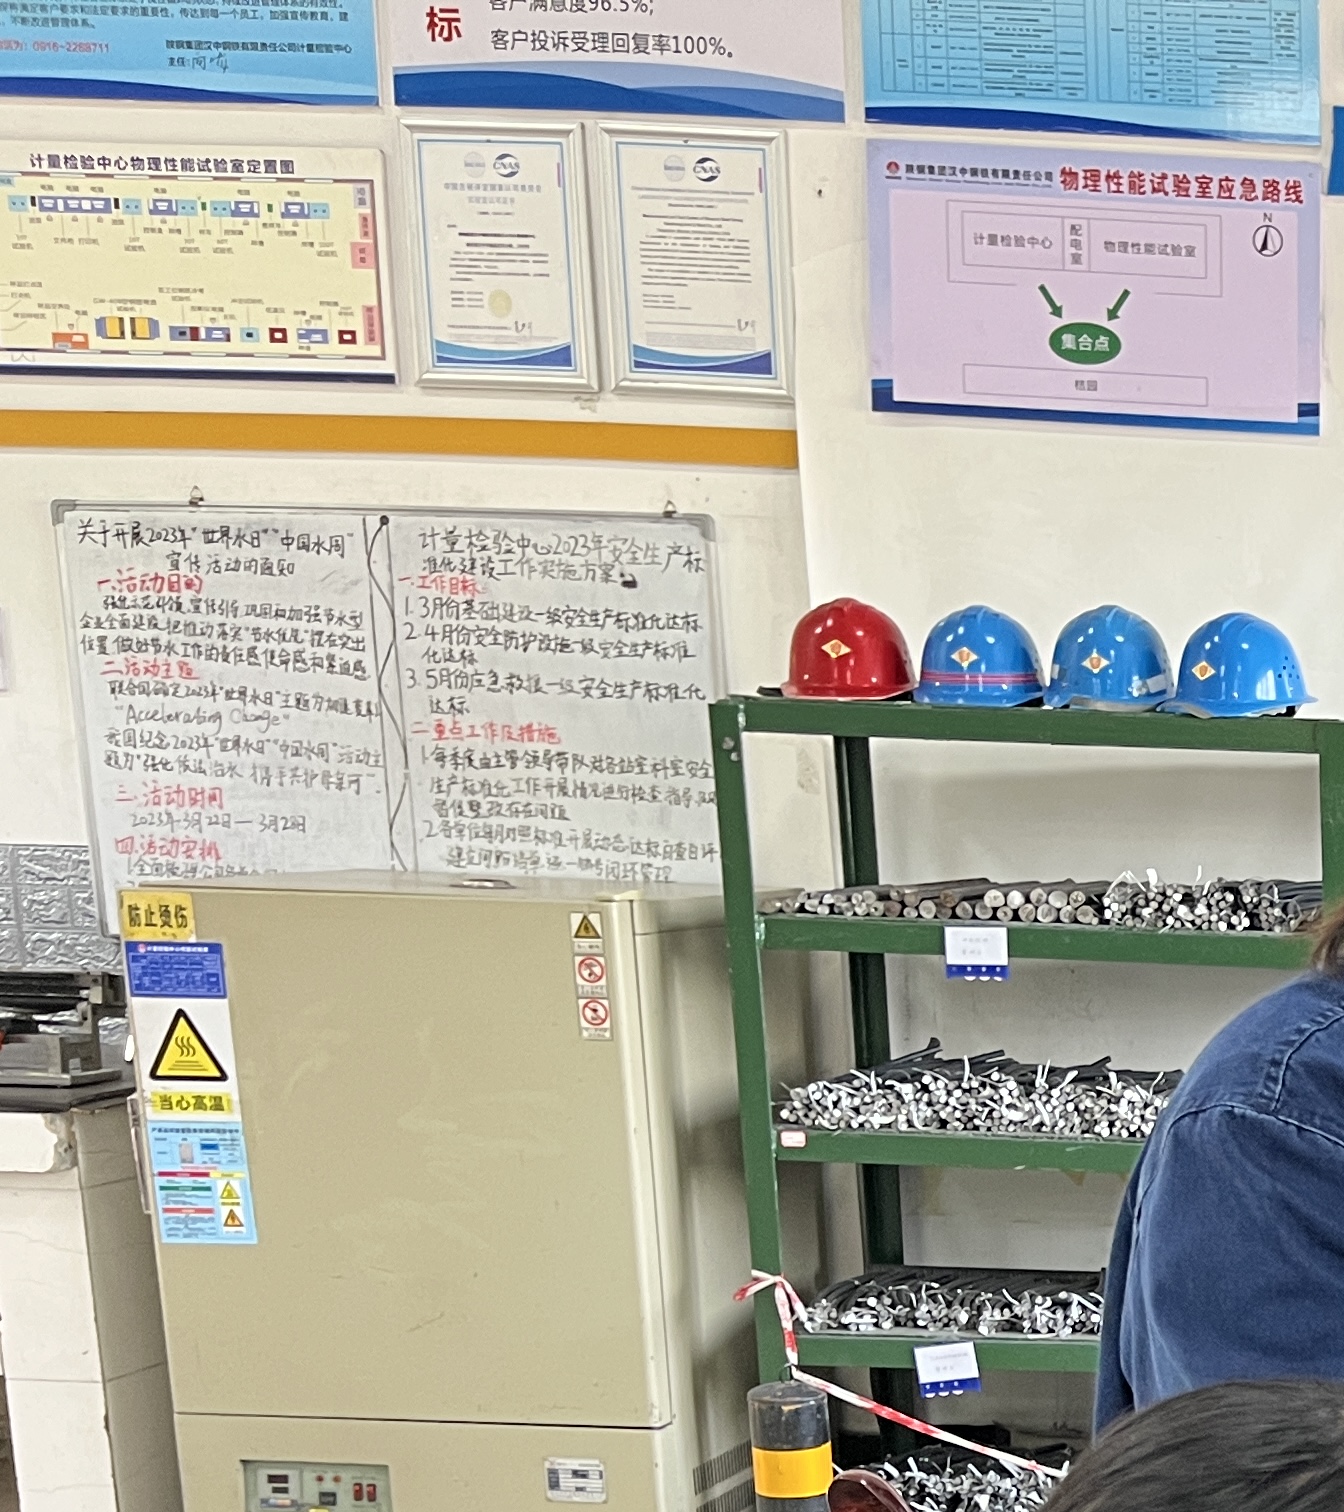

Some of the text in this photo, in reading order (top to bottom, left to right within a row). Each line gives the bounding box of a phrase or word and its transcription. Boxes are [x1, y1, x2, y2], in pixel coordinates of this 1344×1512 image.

[426, 7, 462, 42] 标
[490, 30, 735, 58] 客户投诉受理回复率100%。
[29, 153, 295, 175] 计量检验中心物理性能试验室定置图
[1059, 167, 1305, 205] 物理性能试验室应急路线
[1262, 212, 1273, 223] N
[973, 232, 1053, 250] 计量检验中心
[1070, 223, 1083, 266] 配电室
[1103, 241, 1197, 258] 物理性能试验室
[1061, 333, 1110, 352] 集合点
[421, 645, 478, 669] 化达标
[159, 1094, 226, 1112] 当心高温
